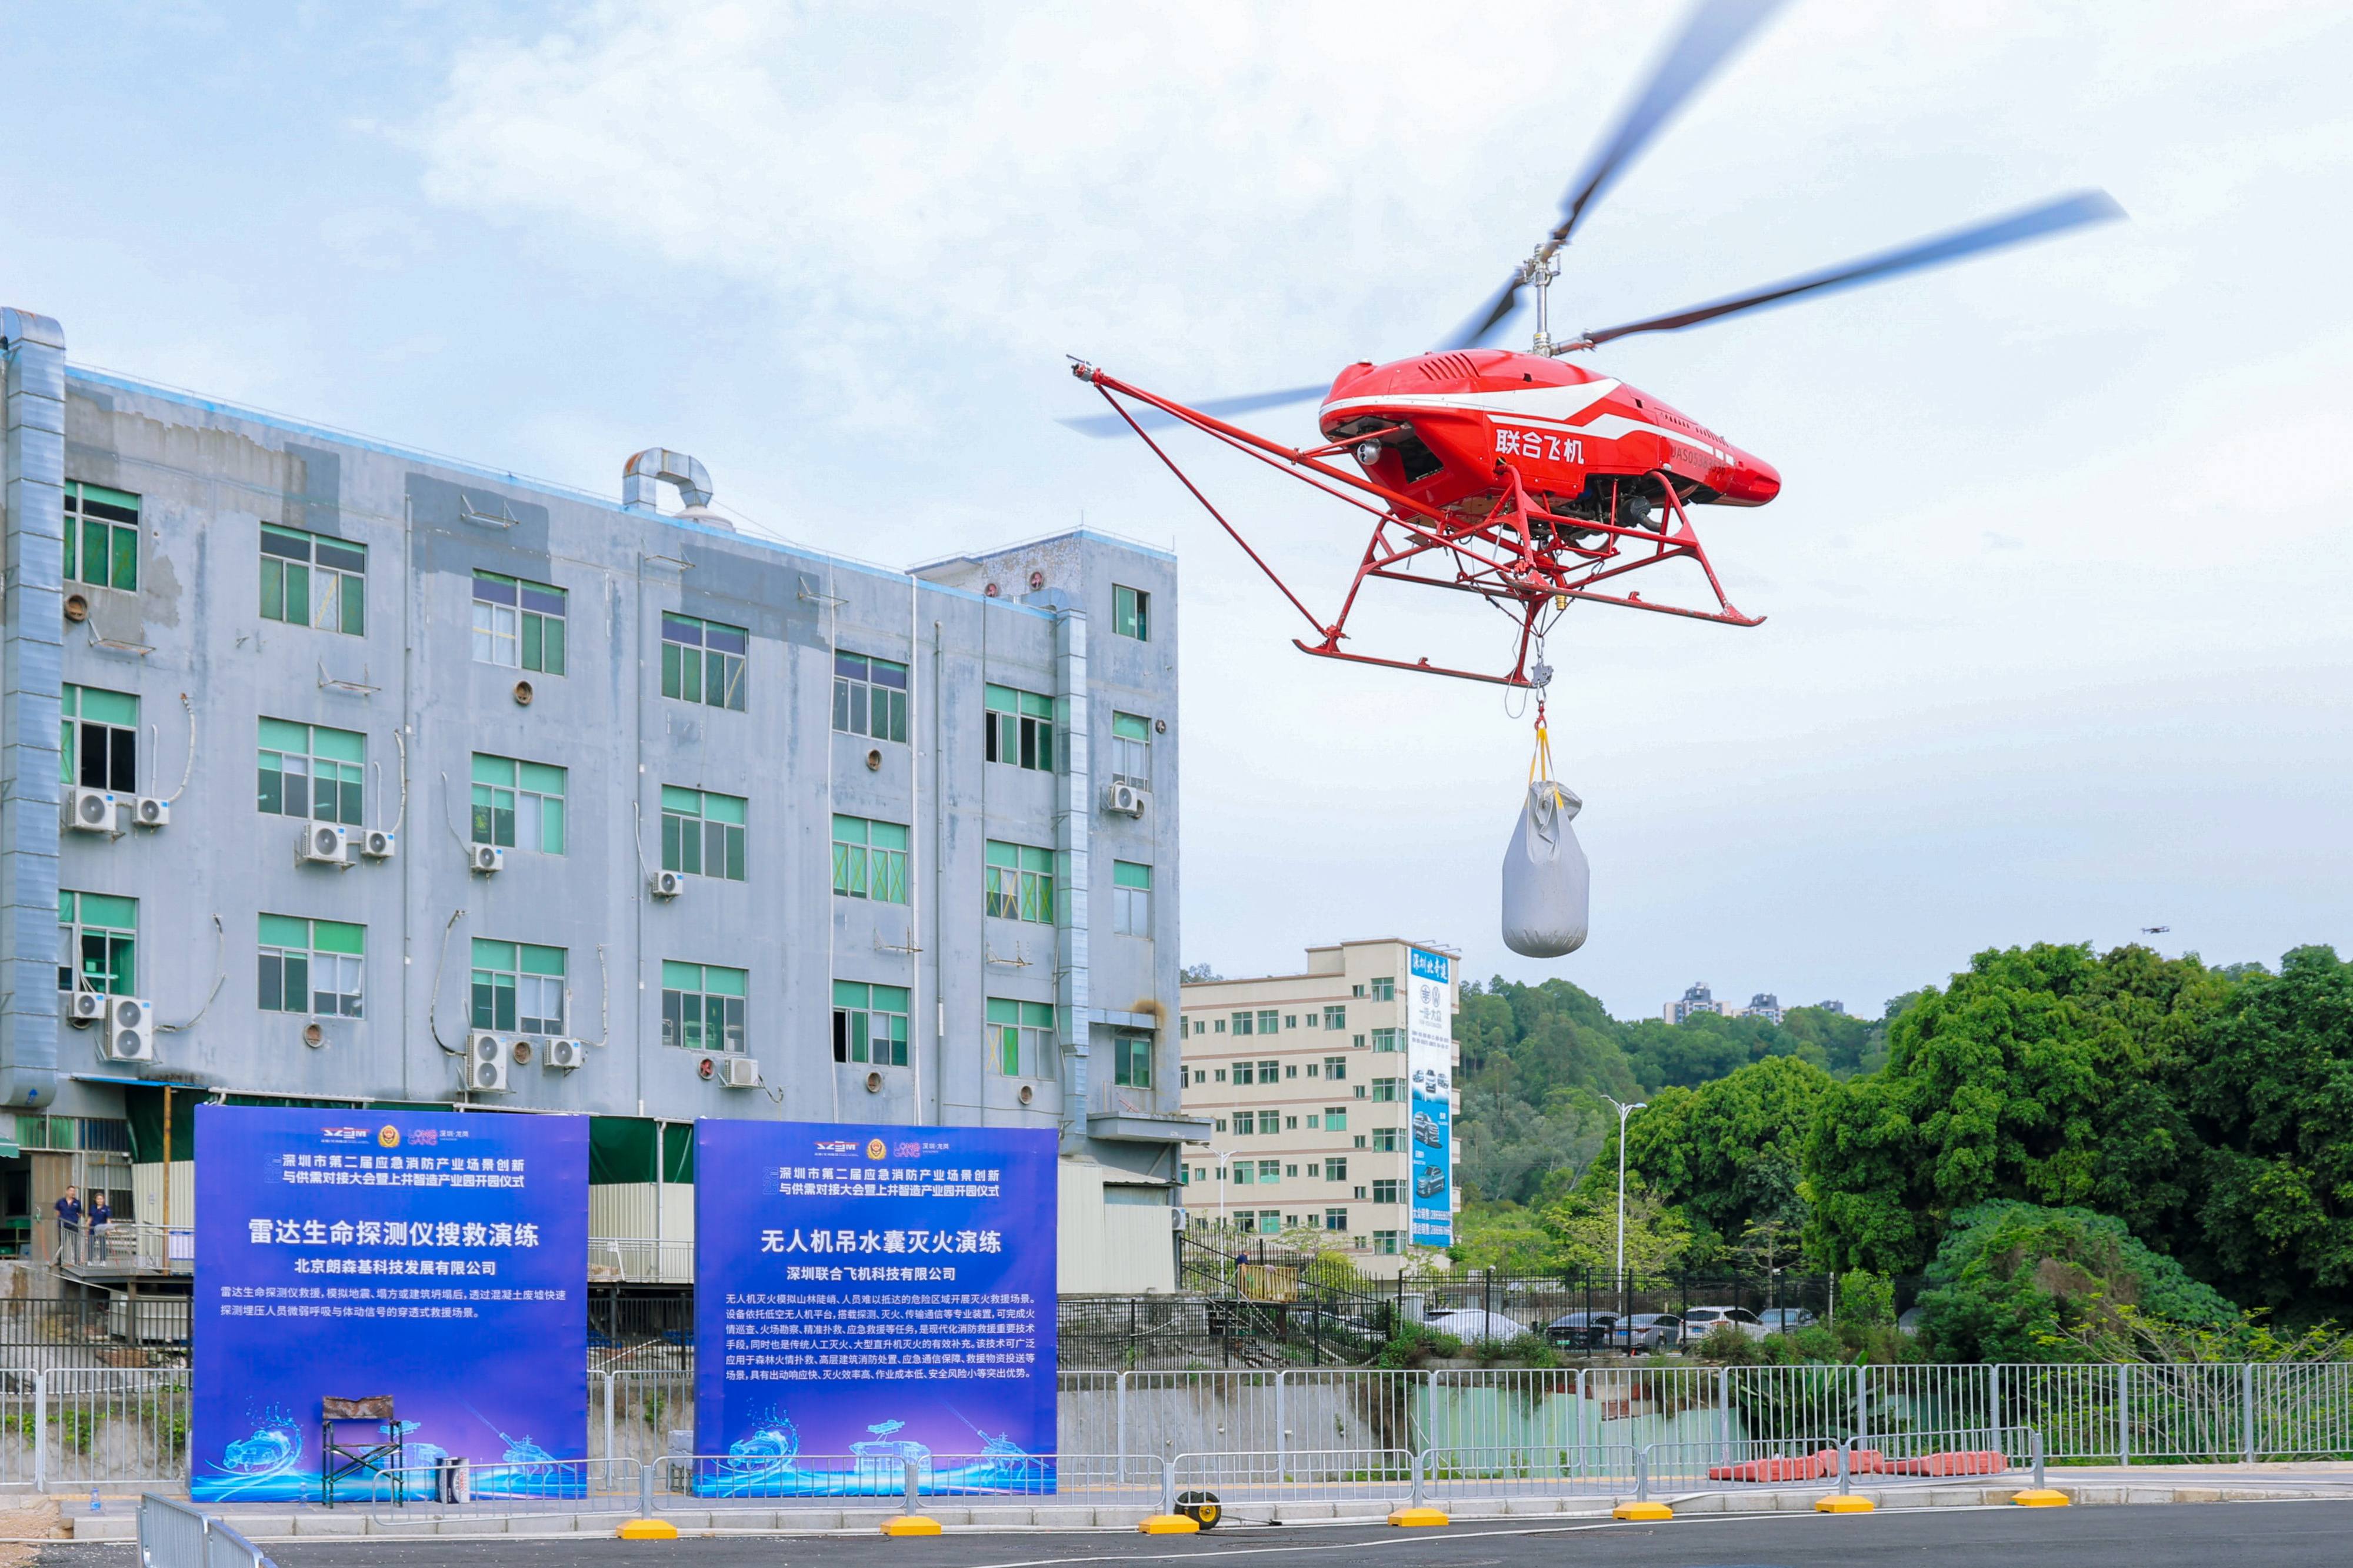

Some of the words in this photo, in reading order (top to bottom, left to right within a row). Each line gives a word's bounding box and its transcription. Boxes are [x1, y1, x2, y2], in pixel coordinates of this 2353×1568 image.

[1495, 429, 1584, 464] 联合飞机
[282, 1154, 525, 1172] 深圳市第二届应急消防产业场景创新
[282, 1170, 525, 1188] 与供需对接大会暨上井智造产业园开园仪式
[779, 1167, 999, 1182] 深圳市第二届应急消防产业场景创新
[779, 1183, 999, 1197] 与供需对接大会暨上井智造产业园开园仪式
[248, 1219, 539, 1247] 雷达生命探测仪搜救演练
[761, 1229, 1001, 1253] 无人机吊水囊灭火演练
[294, 1259, 495, 1276] 北京朗森基科技发展有限公司
[786, 1266, 955, 1281] 深圳联合飞机科技有限公司
[221, 1305, 479, 1318] 探测埋压人员微弱呼吸与体动信号的穿透式救援场景。
